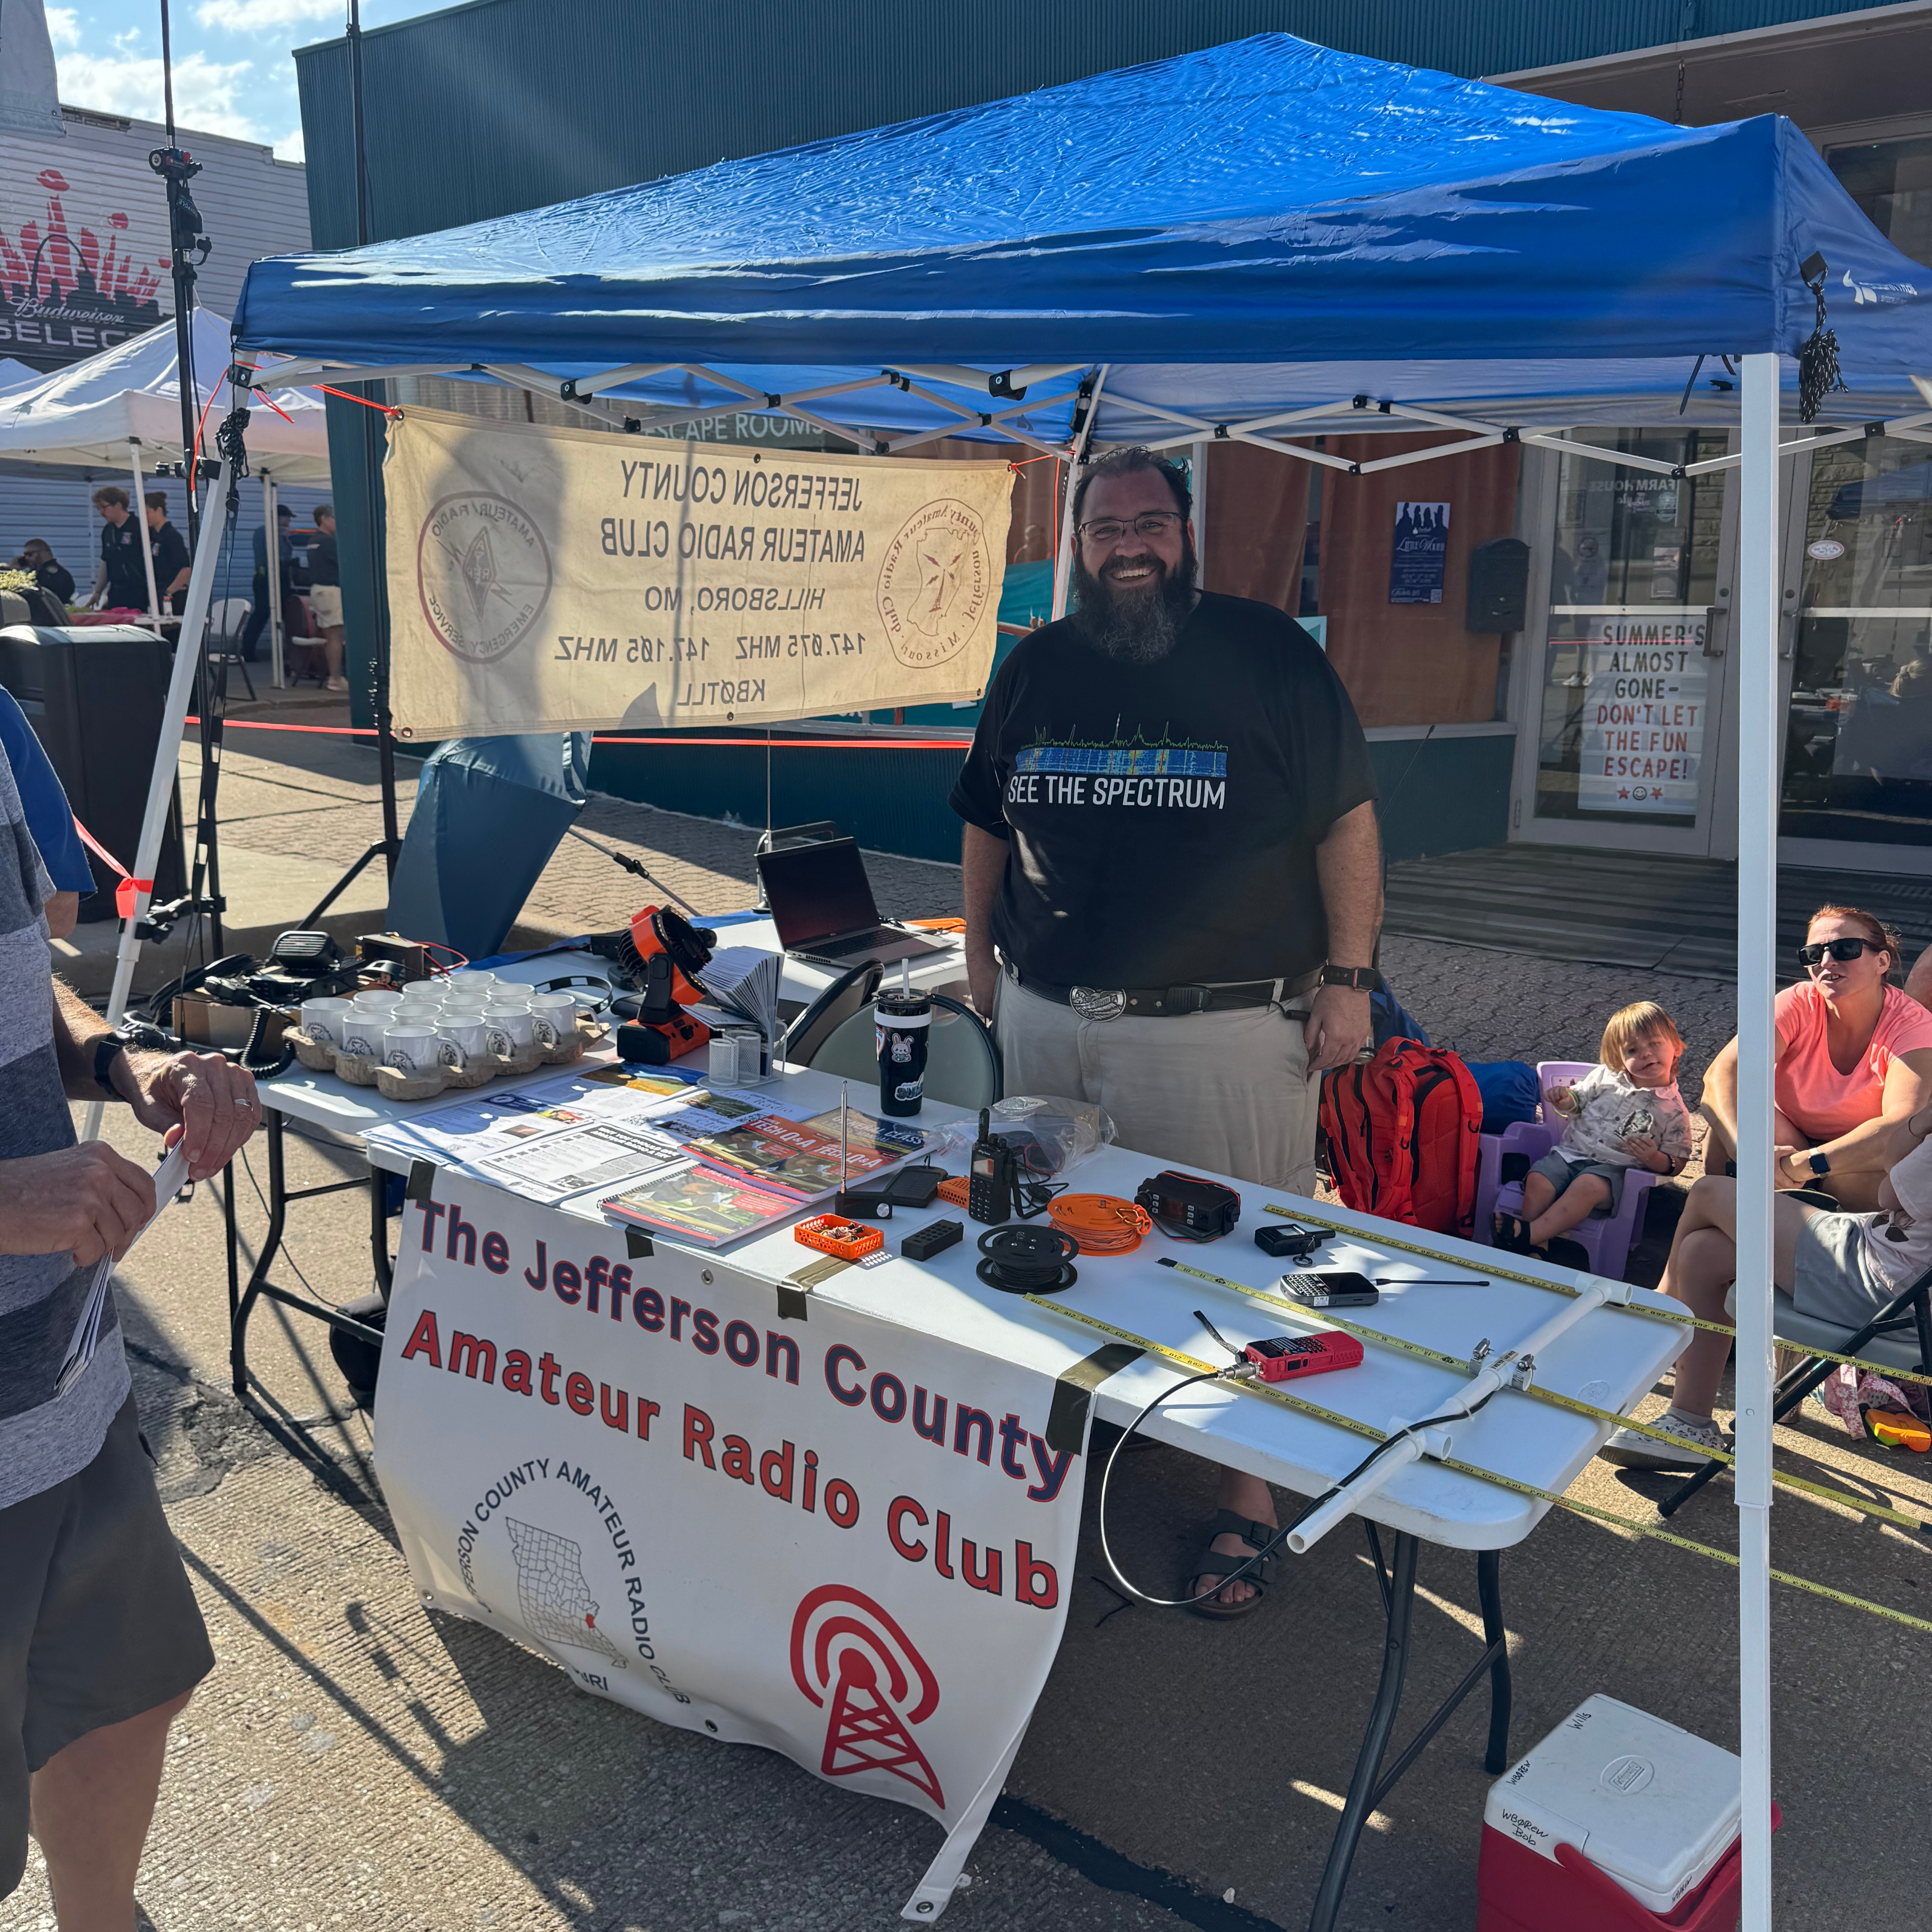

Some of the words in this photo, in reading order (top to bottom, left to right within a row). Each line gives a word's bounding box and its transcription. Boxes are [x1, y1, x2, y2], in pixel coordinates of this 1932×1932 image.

[7, 296, 124, 324] Budweiser
[1603, 625, 1706, 646] SUMMER'S
[1610, 651, 1688, 672] ALMOST
[1597, 704, 1653, 725] DON'T
[1662, 706, 1697, 726] LET
[1605, 731, 1641, 751] THE
[1650, 732, 1688, 752] FUN
[1604, 757, 1688, 779] ESCAPE!
[1008, 775, 1039, 804] SEE
[1045, 776, 1087, 804] THE
[1092, 777, 1226, 810] SPECTRUM
[750, 1119, 785, 1135] TECH
[779, 1132, 816, 1149] Q&A
[884, 1131, 924, 1145] CLASS
[846, 1154, 883, 1169] Q&A
[415, 1200, 510, 1275] The
[524, 1240, 800, 1386] Jefferson
[824, 1343, 1074, 1503] County
[401, 1309, 661, 1441] Amateur
[684, 1403, 860, 1529] Radio
[887, 1495, 1060, 1610] Club
[475, 1458, 550, 1523] COUNTY
[557, 1461, 635, 1571] AMATEUR
[625, 1576, 655, 1660] RADIO
[650, 1665, 691, 1705] CLUB
[1566, 1712, 1592, 1730] Wills
[1512, 1823, 1536, 1845] Bob
